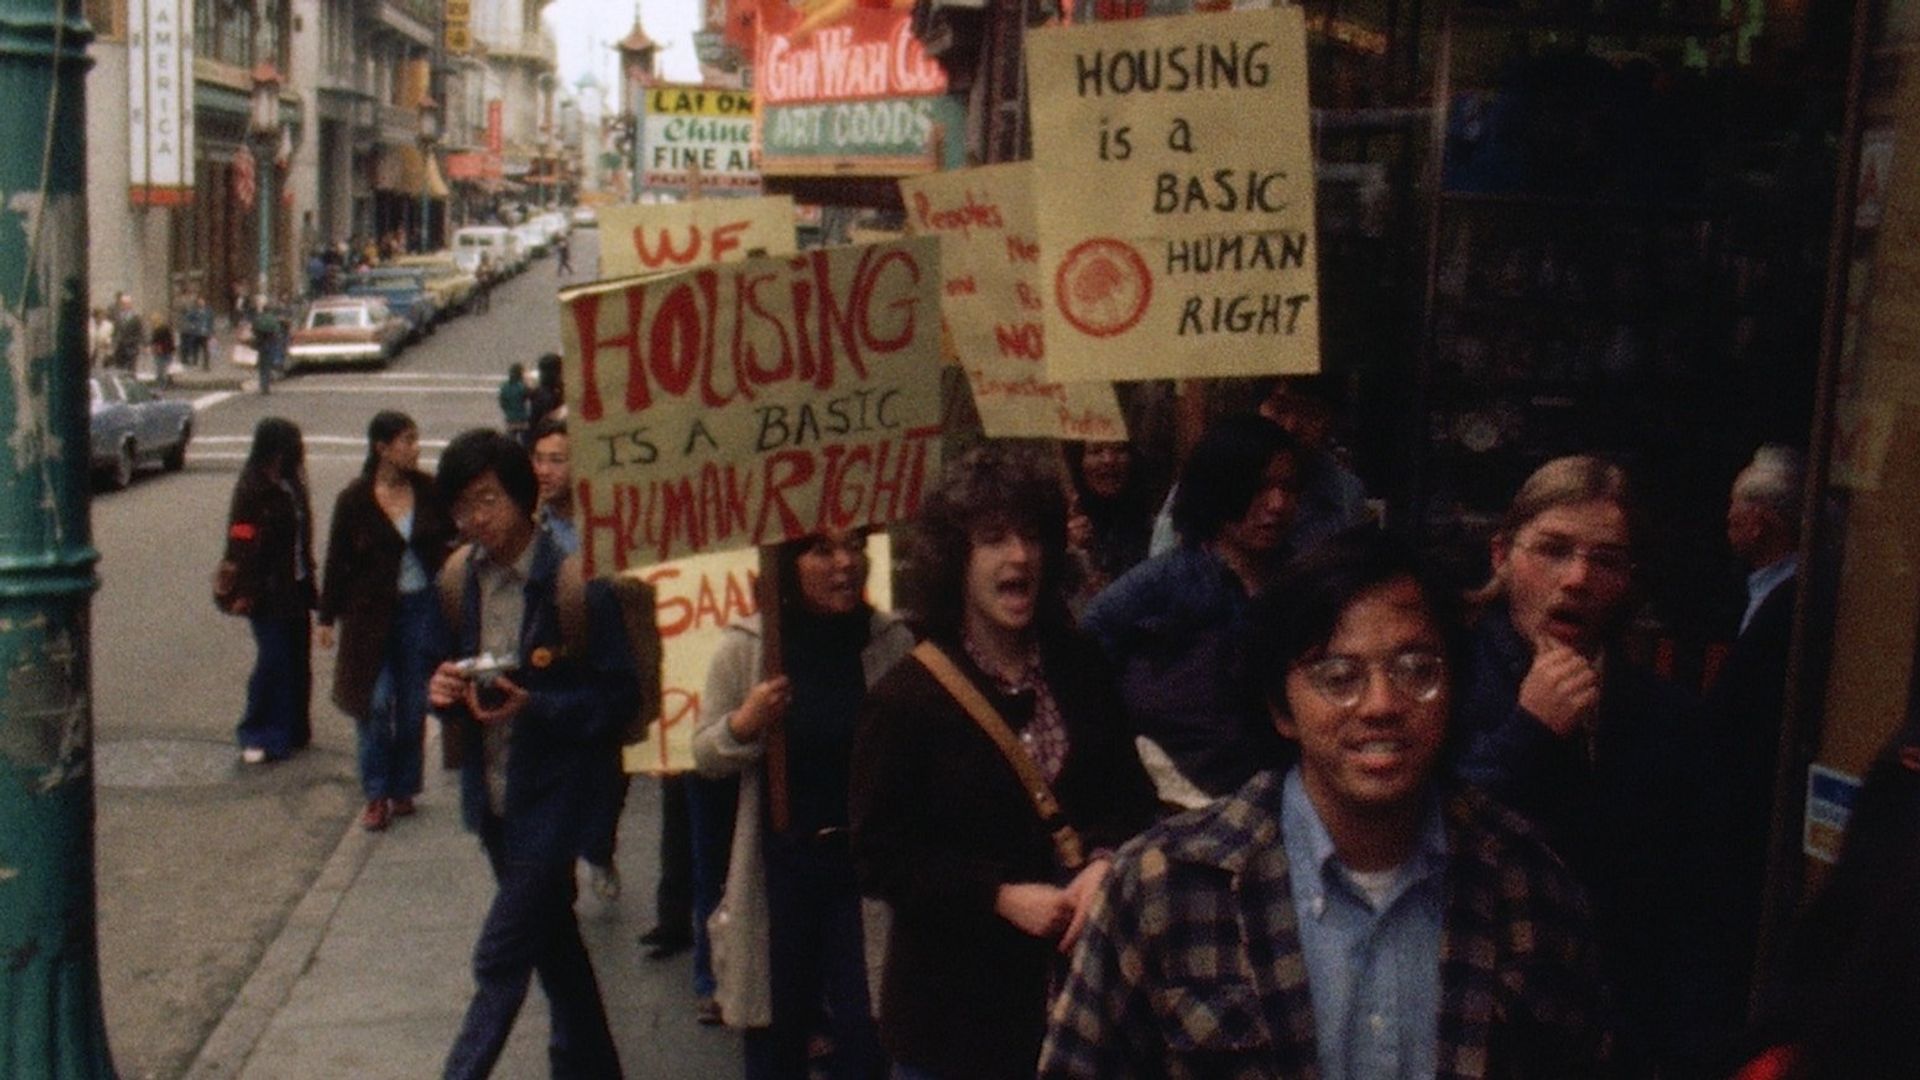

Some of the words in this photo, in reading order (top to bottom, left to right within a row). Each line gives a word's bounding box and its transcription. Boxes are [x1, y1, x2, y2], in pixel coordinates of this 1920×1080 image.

[156, 9, 172, 154] AMERICA
[1075, 41, 1271, 98] HOUSING
[654, 147, 716, 170] FINE
[1099, 118, 1132, 161] is
[1168, 118, 1196, 154] a
[1153, 169, 1288, 215] BASIC
[1166, 232, 1308, 275] HUMAN
[572, 244, 922, 423] HOUSING
[1178, 294, 1310, 336] RIGHT
[597, 427, 658, 468] IS
[684, 418, 719, 457] A
[756, 389, 901, 453] BASIC
[576, 460, 752, 581] HUMAN
[751, 425, 943, 547] RIGHT
